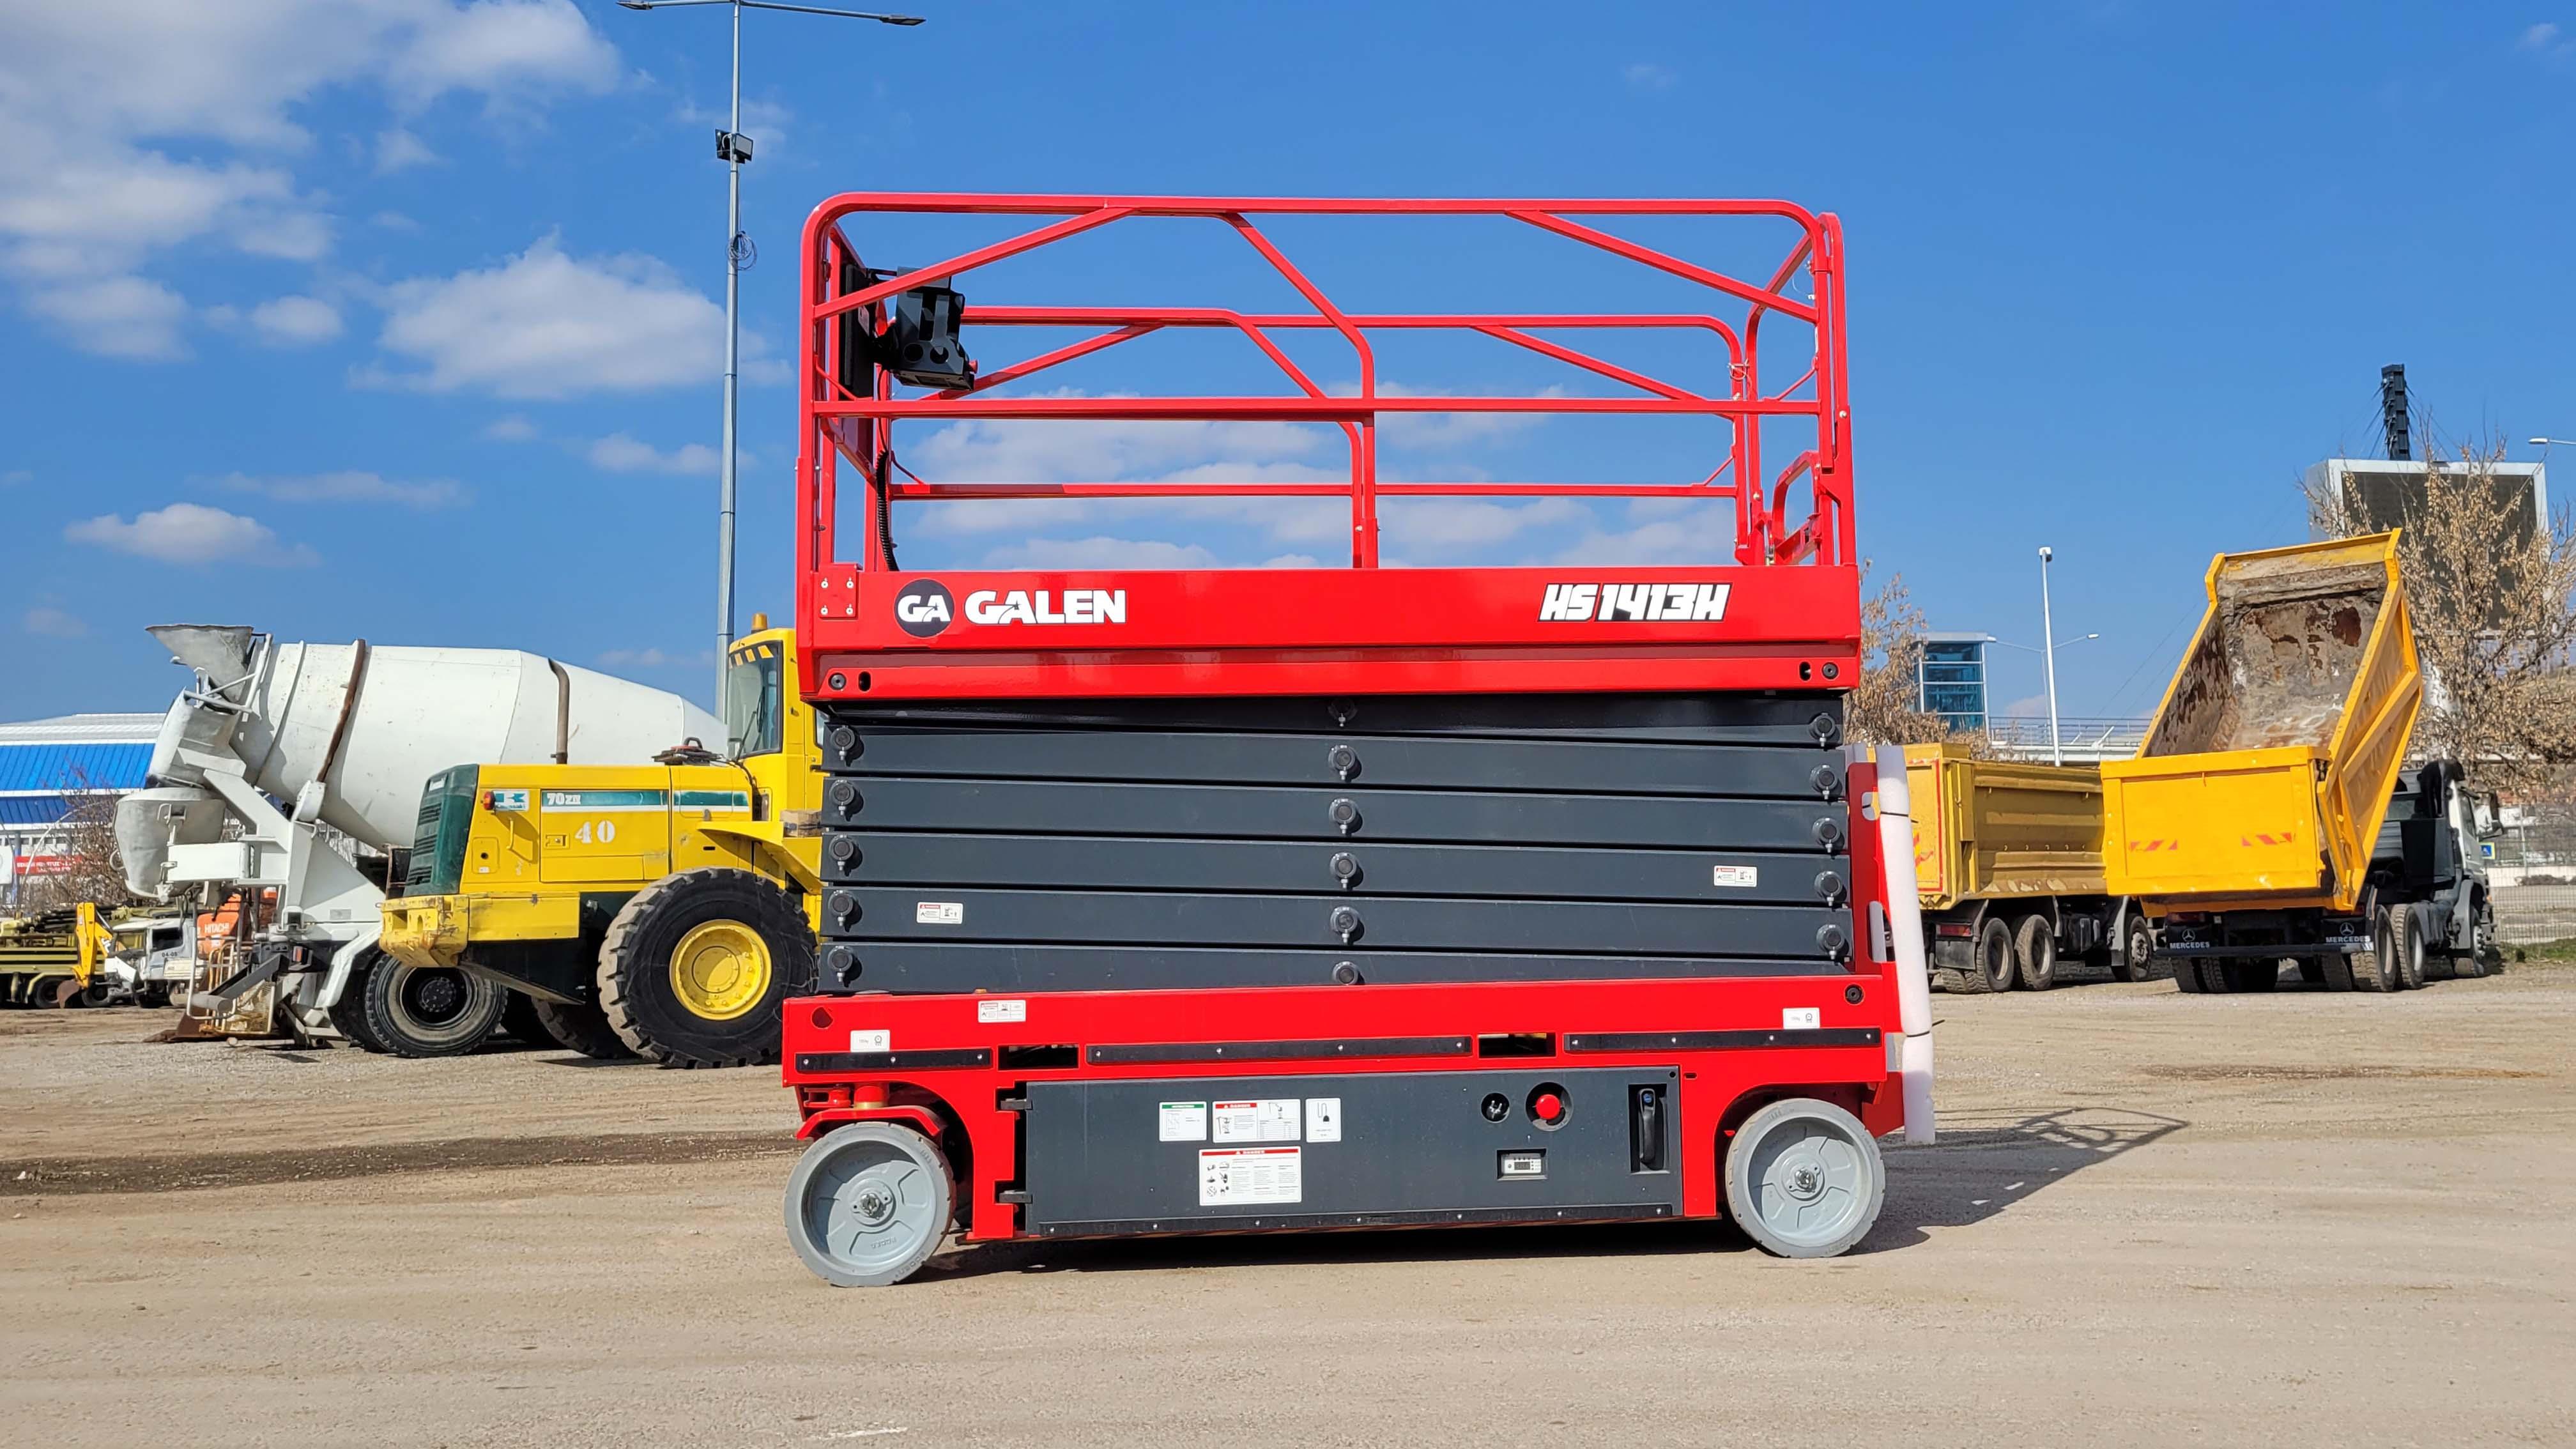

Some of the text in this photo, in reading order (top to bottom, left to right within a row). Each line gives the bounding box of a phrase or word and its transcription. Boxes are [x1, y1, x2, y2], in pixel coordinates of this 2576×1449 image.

[897, 589, 1127, 624] GA GALEN
[1538, 583, 1732, 621] HS1413H
[574, 820, 616, 843] 40
[204, 922, 230, 933] HITACHI
[2169, 941, 2211, 950] MERCEDES
[2326, 935, 2371, 943] MERCEDES
